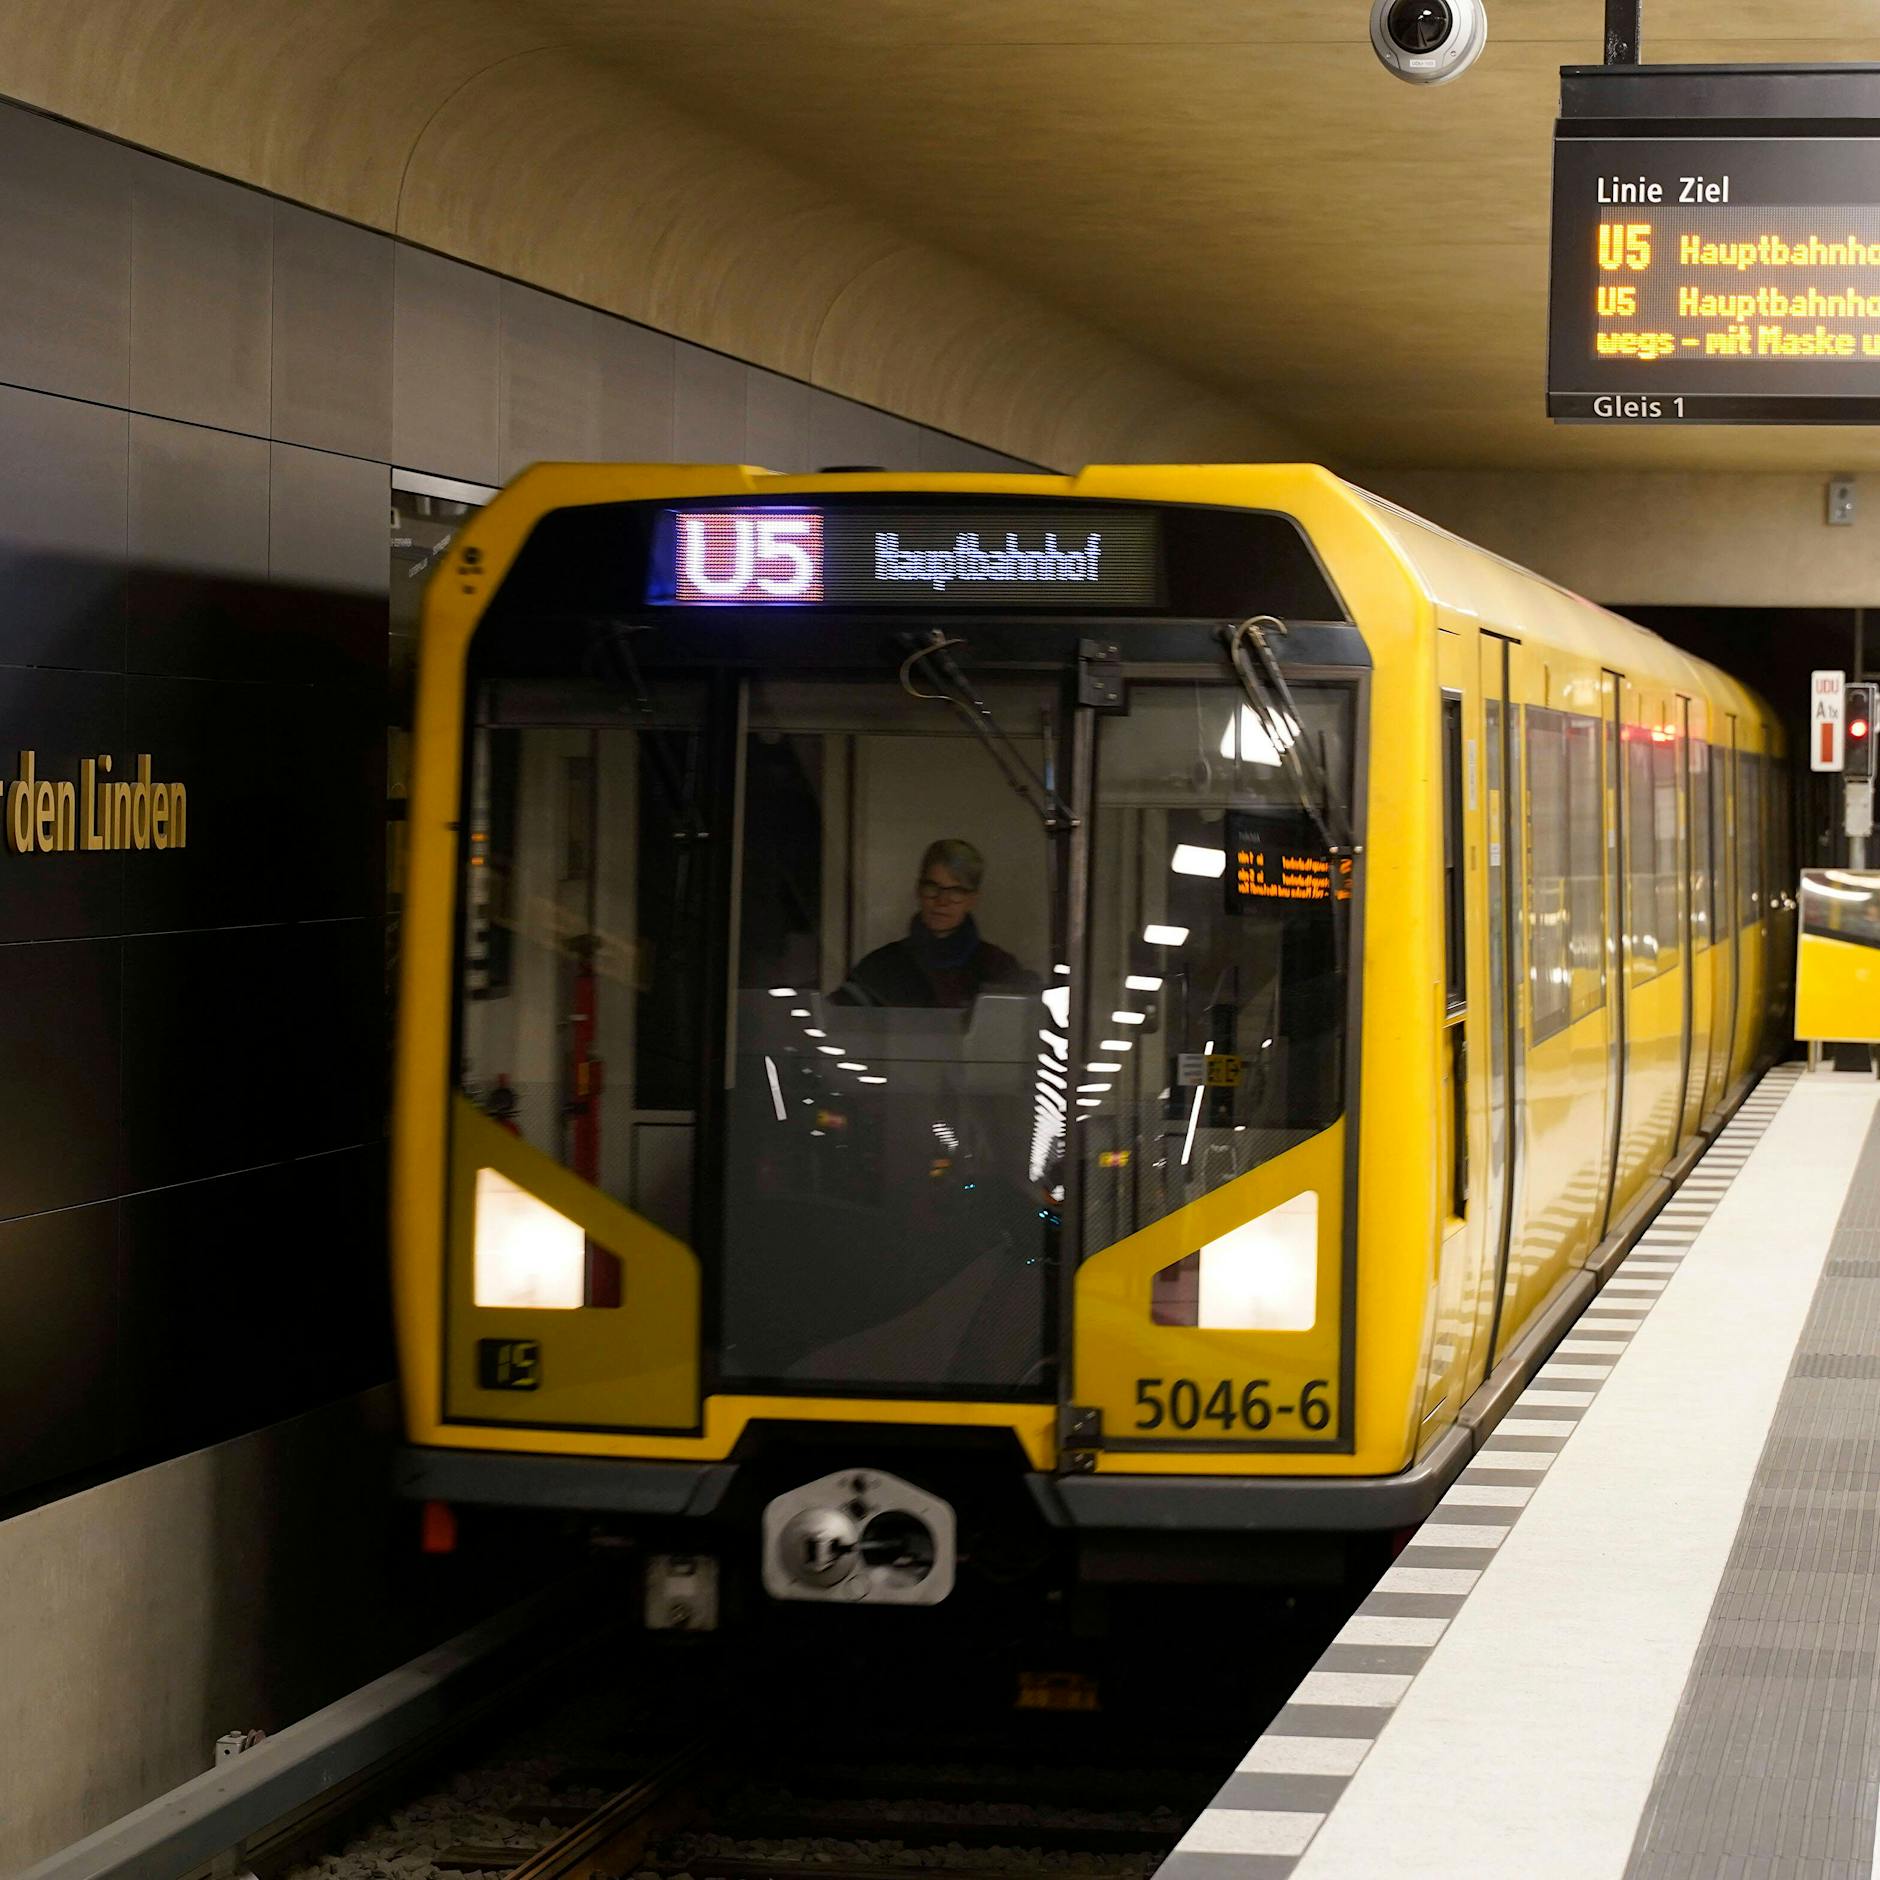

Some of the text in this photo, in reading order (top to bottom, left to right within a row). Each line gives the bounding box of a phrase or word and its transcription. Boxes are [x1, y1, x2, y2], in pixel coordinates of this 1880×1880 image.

[1597, 175, 1730, 203] Linie Ziel
[1597, 224, 1652, 270] U5
[1596, 286, 1637, 317] U5
[1596, 332, 1676, 360] wegs
[1705, 325, 1752, 354] mit
[1758, 325, 1857, 355] Maske
[1593, 395, 1684, 418] Gleis 1
[684, 519, 815, 596] U5
[6, 750, 187, 853] den Linden
[1135, 1378, 1331, 1431] 5046-6
